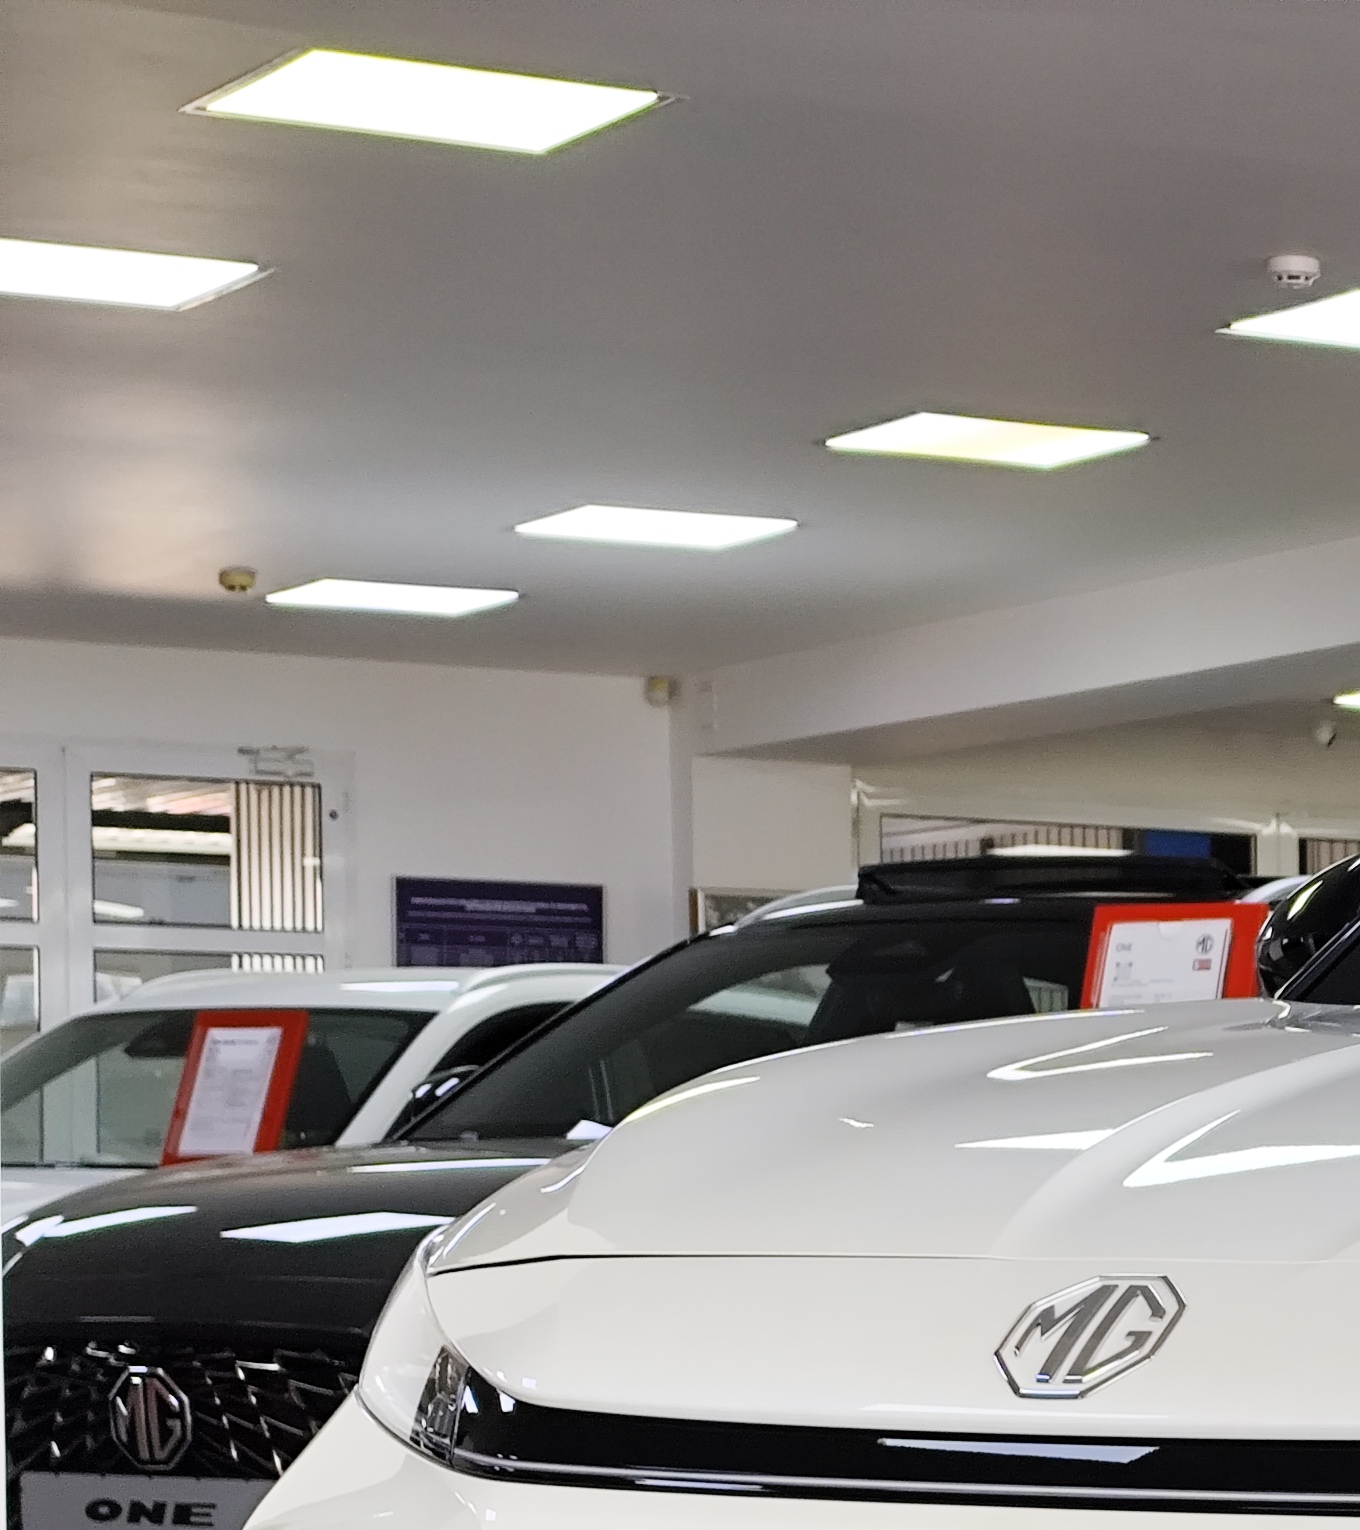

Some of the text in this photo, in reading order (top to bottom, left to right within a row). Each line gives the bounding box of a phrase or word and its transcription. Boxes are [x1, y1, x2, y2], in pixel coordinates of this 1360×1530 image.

[1012, 1284, 1166, 1384] MG
[114, 1375, 183, 1462] MG
[85, 1498, 217, 1527] ONE
